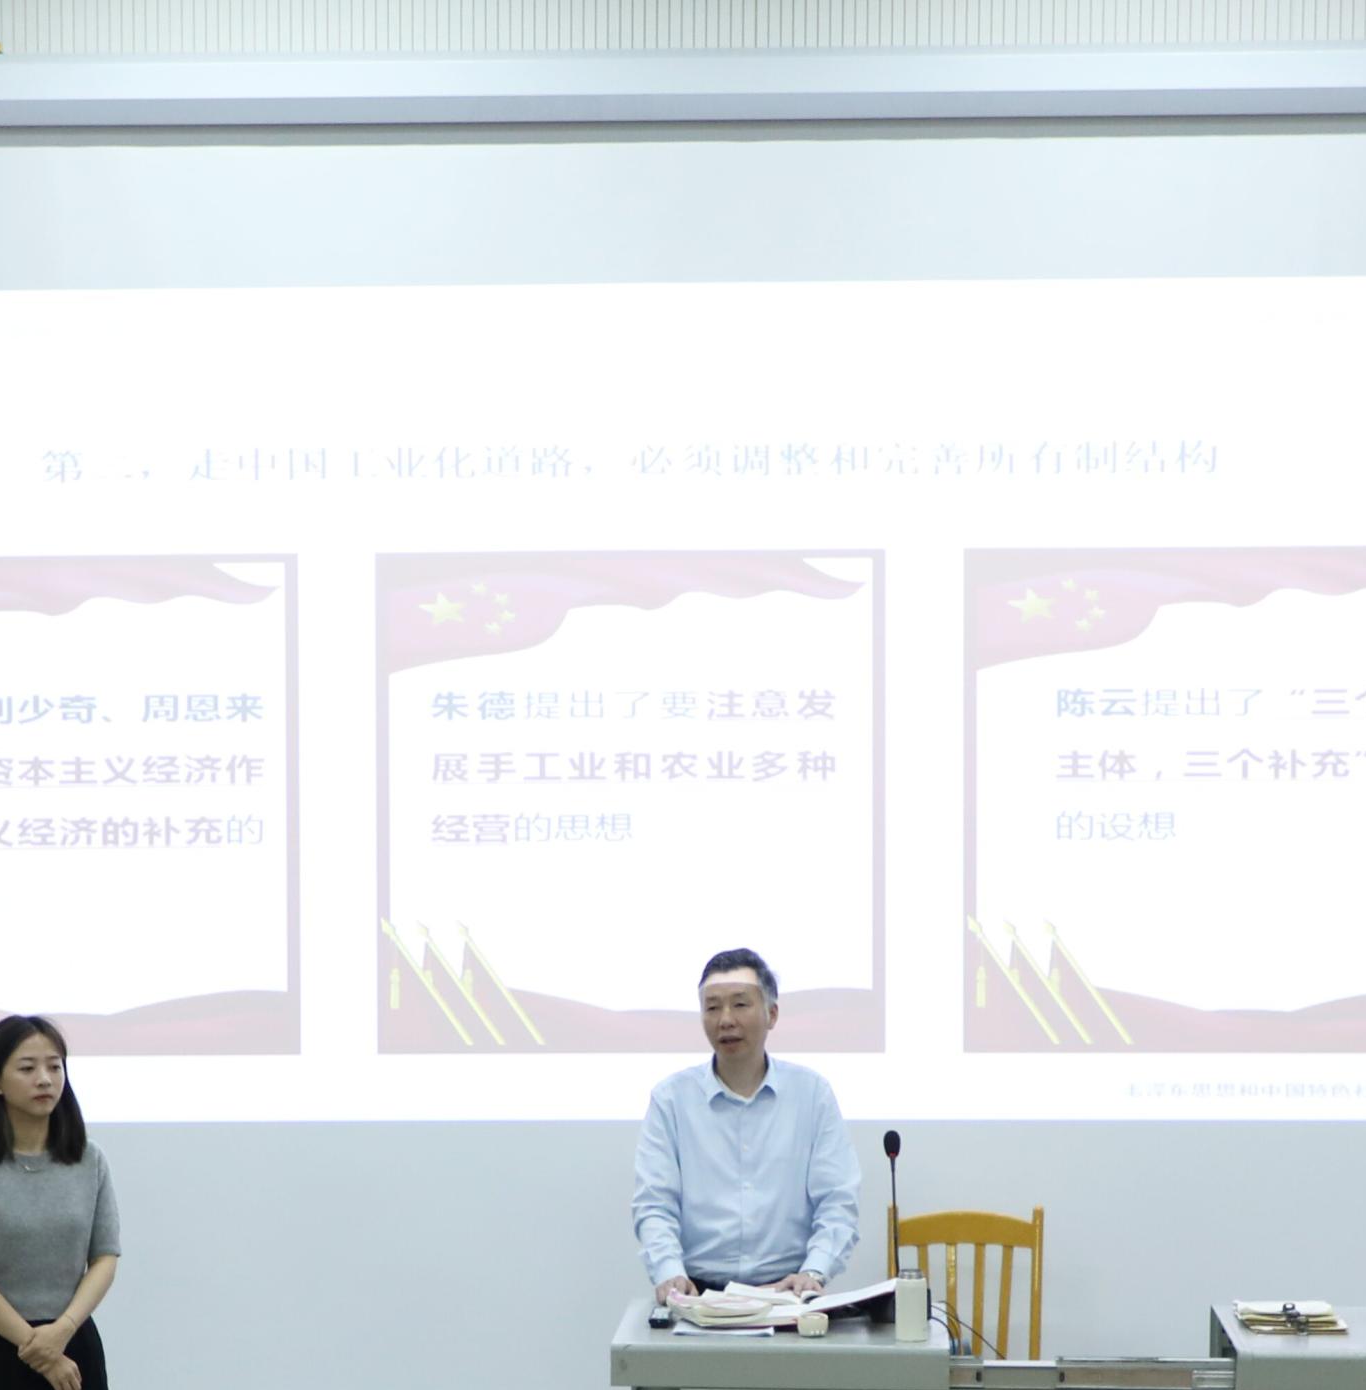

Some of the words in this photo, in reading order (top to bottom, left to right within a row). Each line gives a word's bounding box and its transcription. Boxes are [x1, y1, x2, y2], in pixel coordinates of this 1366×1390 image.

[431, 688, 835, 721] 朱德提出了要注意发
[431, 749, 835, 783] 展手工业和农业多种
[431, 812, 632, 844] 经营的思想
[1055, 810, 1176, 840] 的设想
